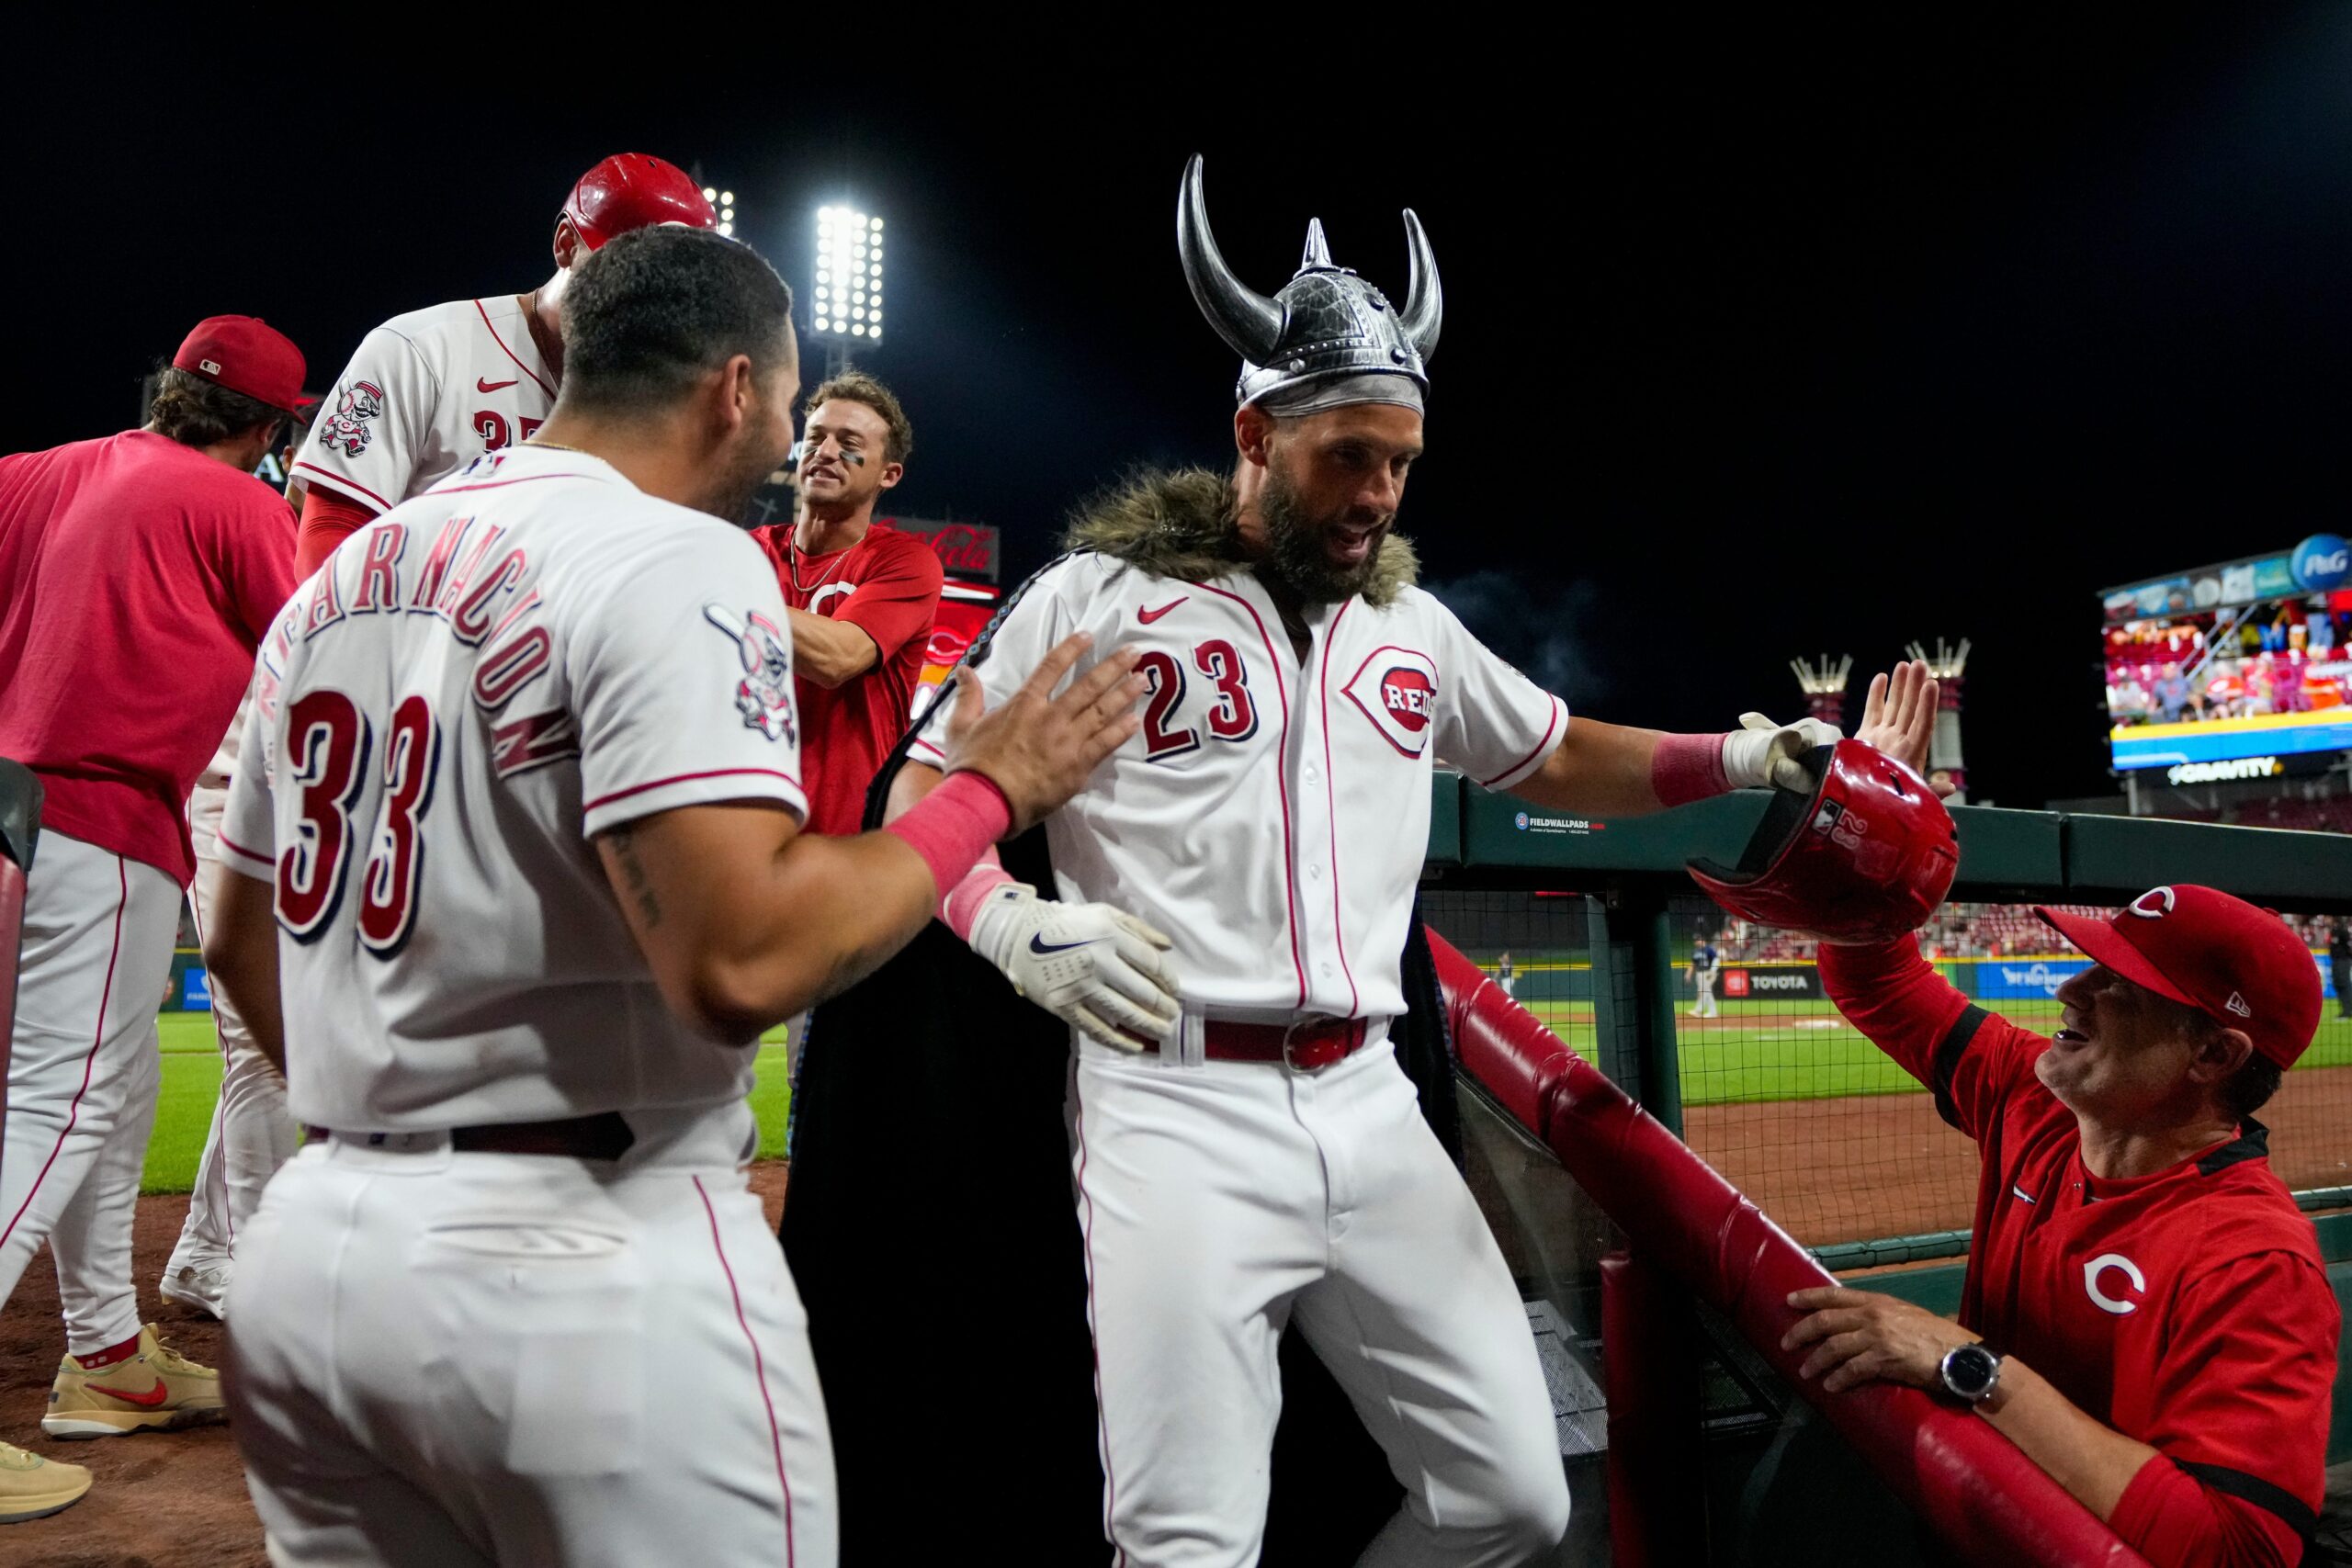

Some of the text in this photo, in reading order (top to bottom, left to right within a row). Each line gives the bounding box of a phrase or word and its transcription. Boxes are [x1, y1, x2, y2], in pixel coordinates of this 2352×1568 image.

[1132, 639, 1259, 764] 23
[275, 687, 442, 963] 33
[1831, 808, 1869, 850] 23
[2128, 886, 2176, 918] C
[1750, 976, 1808, 990] TOYOTA
[2083, 1253, 2146, 1314] C
